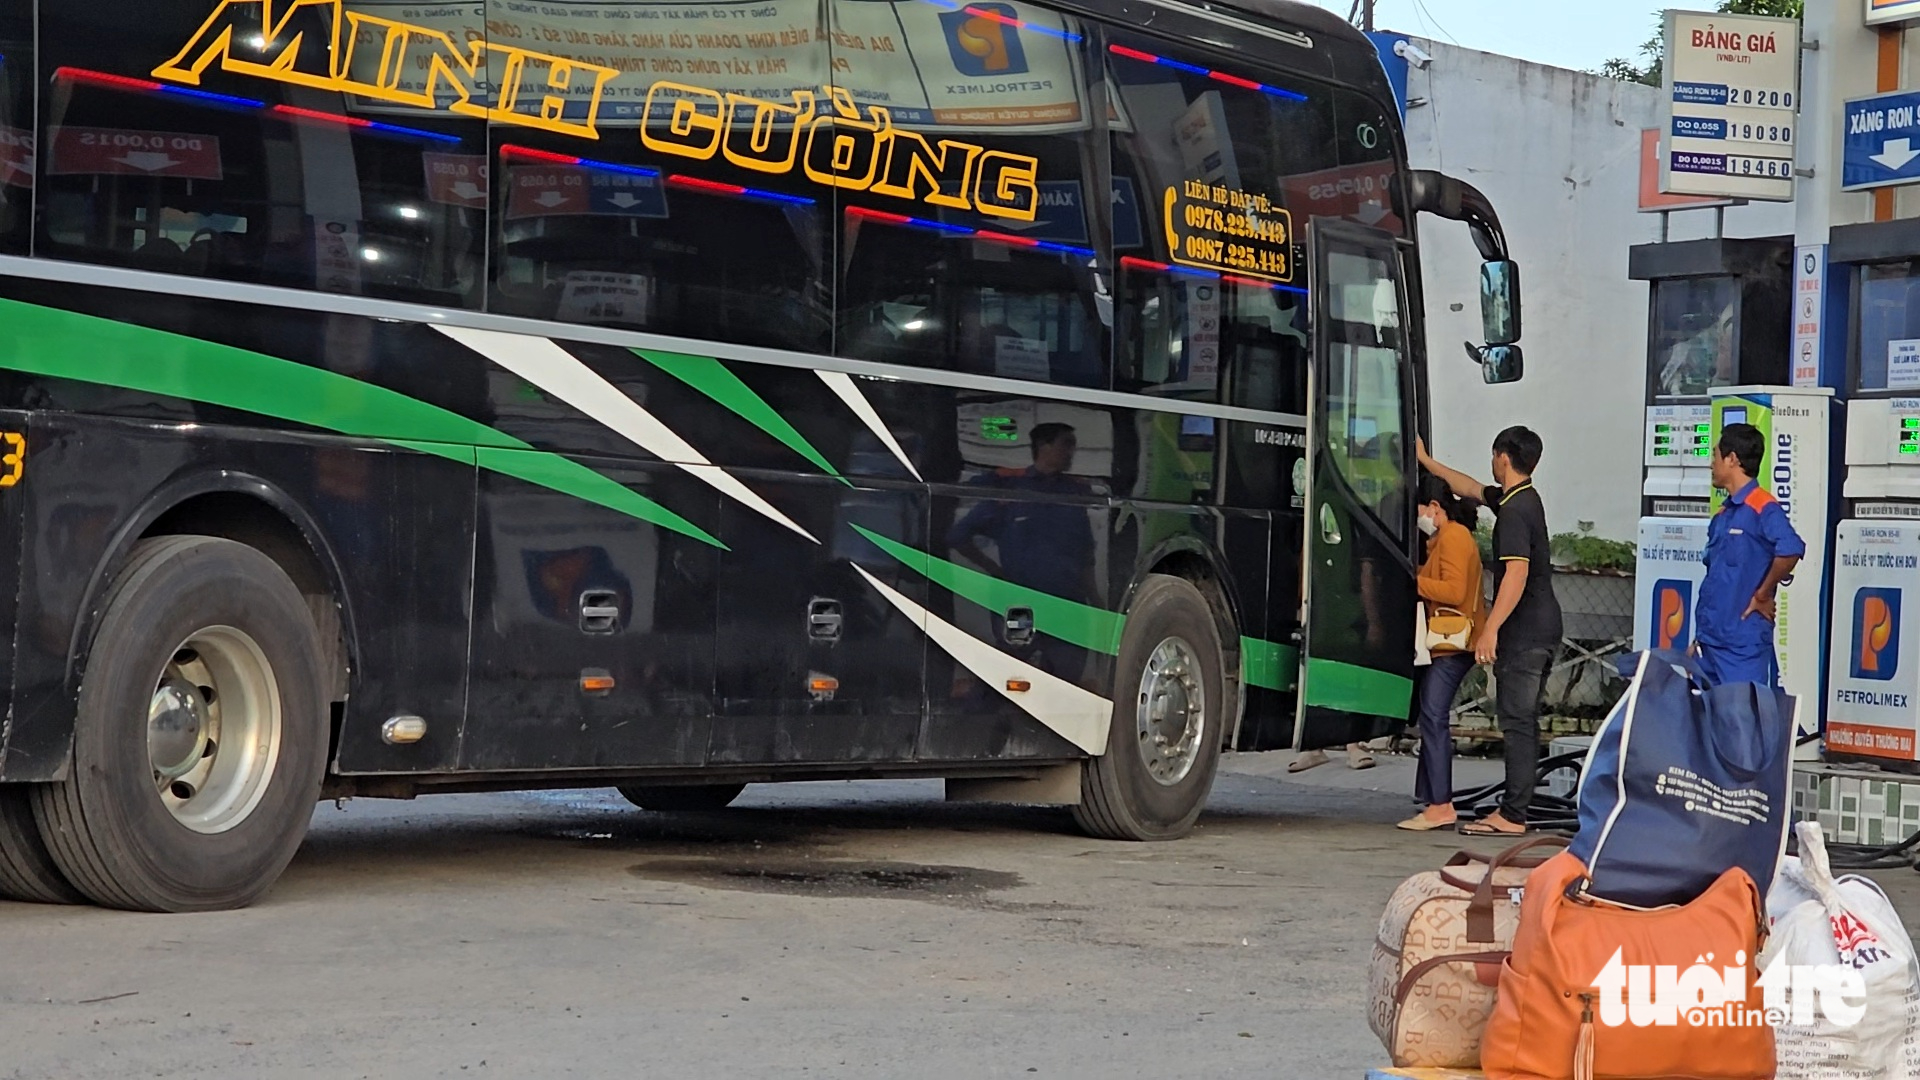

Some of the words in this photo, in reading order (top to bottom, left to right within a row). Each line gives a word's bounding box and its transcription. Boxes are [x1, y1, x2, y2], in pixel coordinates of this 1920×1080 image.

[1692, 23, 1741, 51] BẢNG
[1747, 31, 1776, 53] GIÁ
[1694, 87, 1709, 96] RON
[1730, 88, 1792, 108] 20200
[151, 0, 621, 140] MINH
[640, 80, 1039, 222] CƯỜNG
[1850, 109, 1884, 134] XĂNG
[1887, 106, 1913, 129] RON
[1676, 120, 1692, 130] DO
[1731, 123, 1791, 143] 19030
[1678, 155, 1691, 163] DO
[1692, 156, 1722, 166] 0,001S
[1731, 159, 1790, 177] 19460
[1184, 179, 1210, 200] LIÊN
[1212, 184, 1228, 208] HỆ
[1230, 188, 1252, 212] ĐẶT
[1186, 235, 1286, 275] 0987.225.443
[1836, 689, 1908, 708] PETROLIMEX
[1722, 788, 1749, 799] HOTEL
